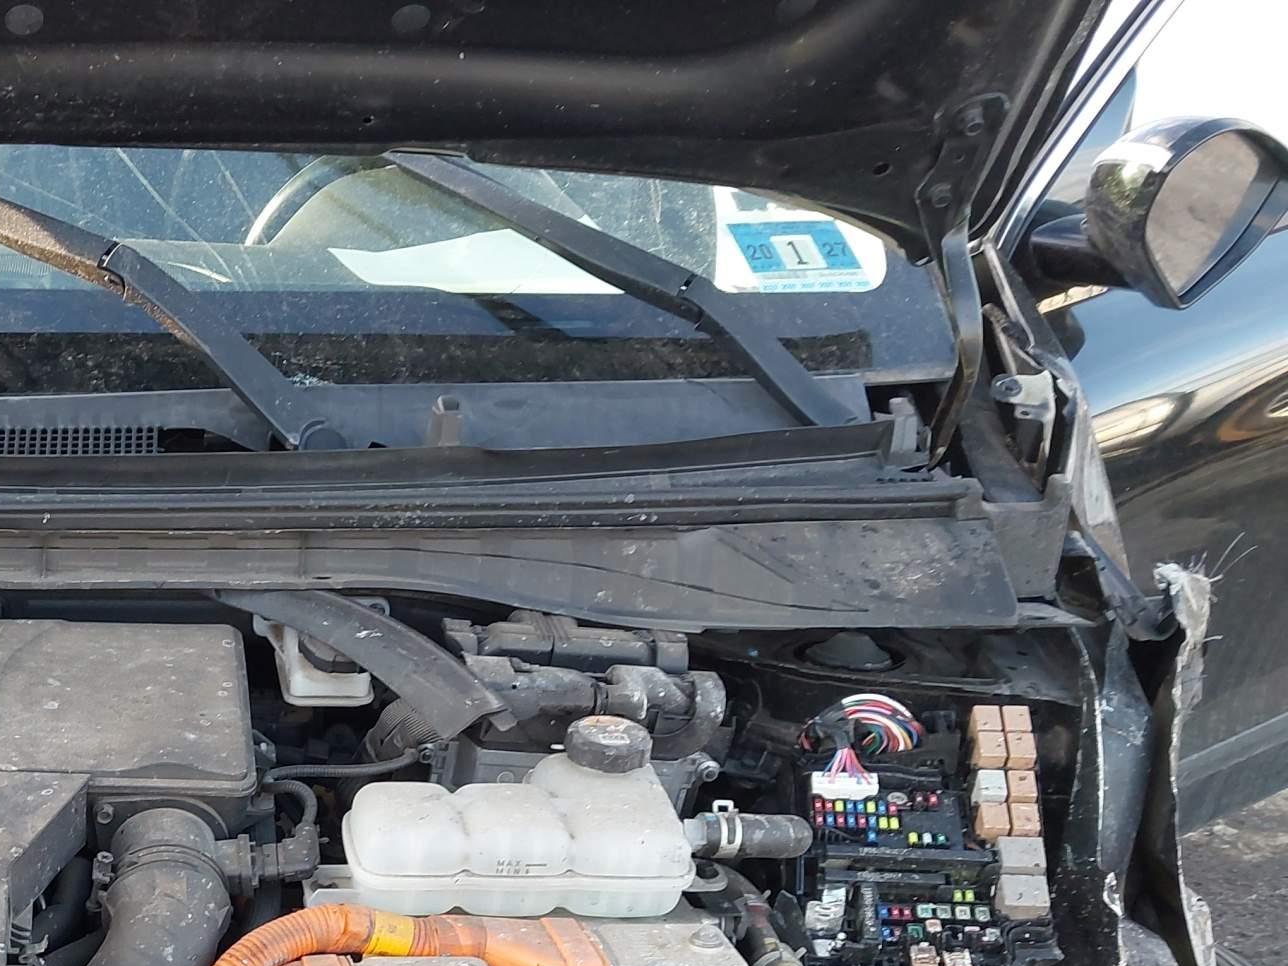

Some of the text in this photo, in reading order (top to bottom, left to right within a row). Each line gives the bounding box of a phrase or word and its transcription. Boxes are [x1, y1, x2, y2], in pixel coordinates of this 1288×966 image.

[746, 240, 848, 265] 20 1 27
